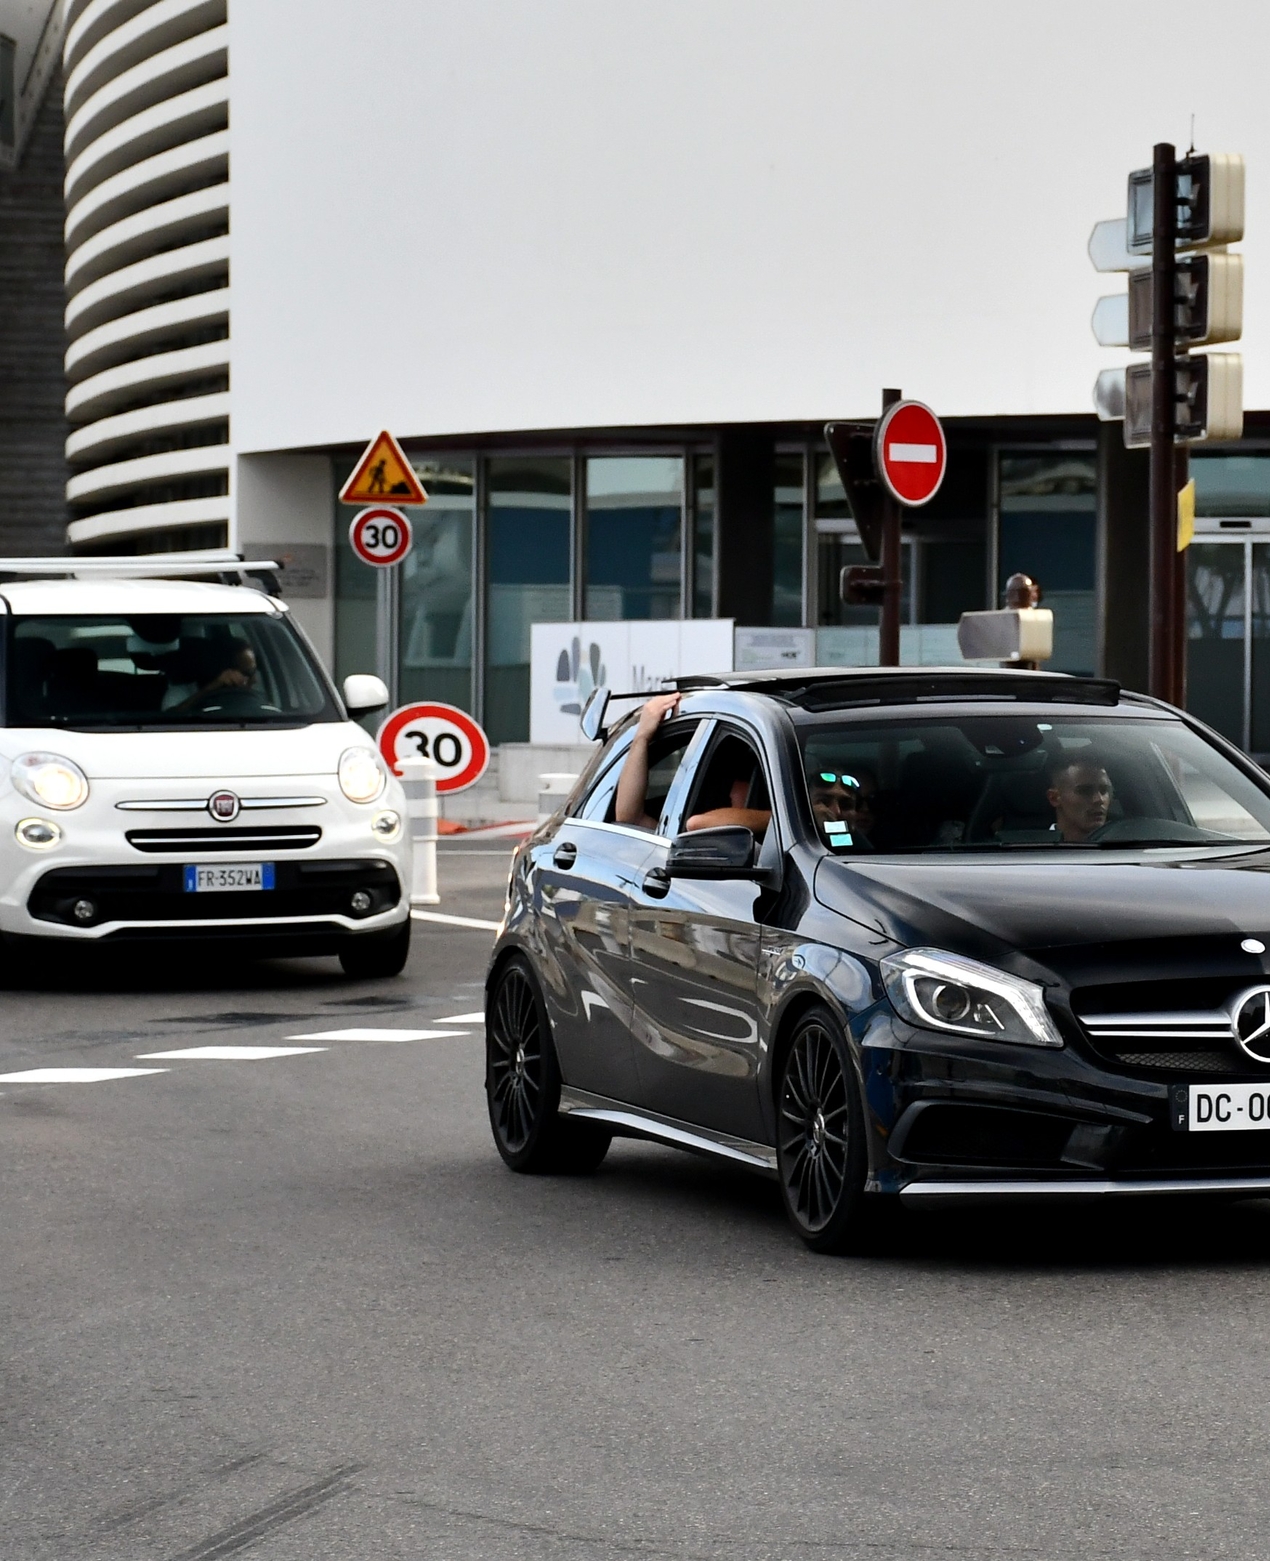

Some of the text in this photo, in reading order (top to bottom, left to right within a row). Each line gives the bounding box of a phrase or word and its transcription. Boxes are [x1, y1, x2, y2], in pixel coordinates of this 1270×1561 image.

[365, 525, 398, 549] 30
[405, 731, 462, 767] 30
[1178, 1115, 1185, 1124] F
